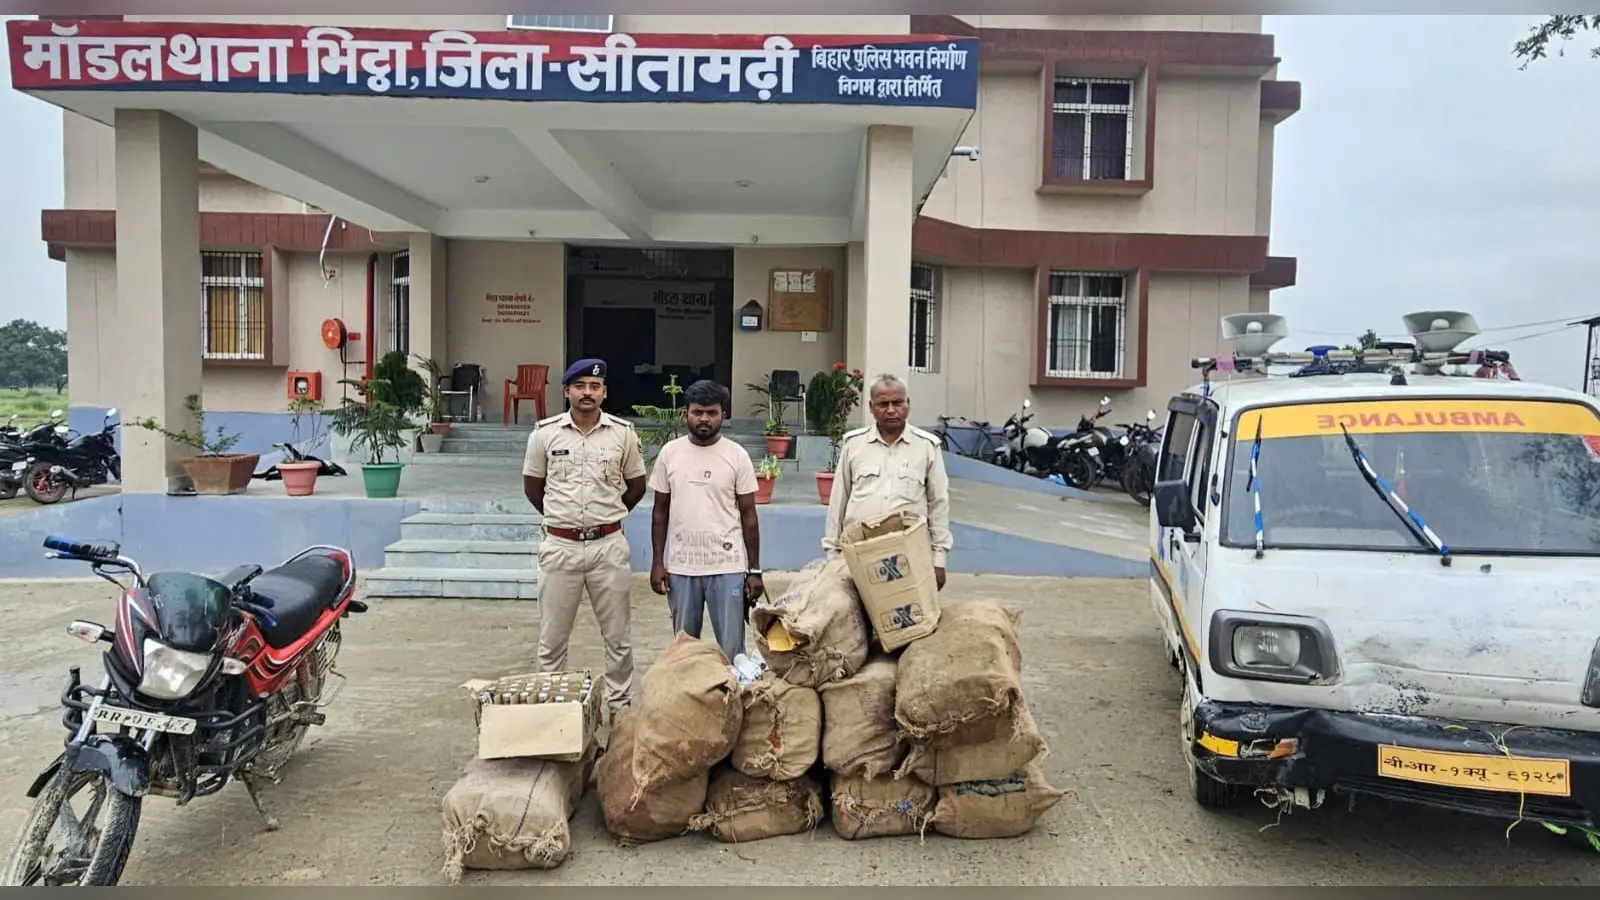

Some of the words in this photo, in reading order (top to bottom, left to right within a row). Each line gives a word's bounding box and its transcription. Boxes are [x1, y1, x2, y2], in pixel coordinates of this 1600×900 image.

[811, 44, 851, 71] बिहार
[853, 45, 892, 72] पुलिस
[893, 49, 925, 70] भवन
[926, 43, 968, 71] निर्माण
[837, 75, 875, 96] निगम
[877, 78, 902, 99] द्वारा
